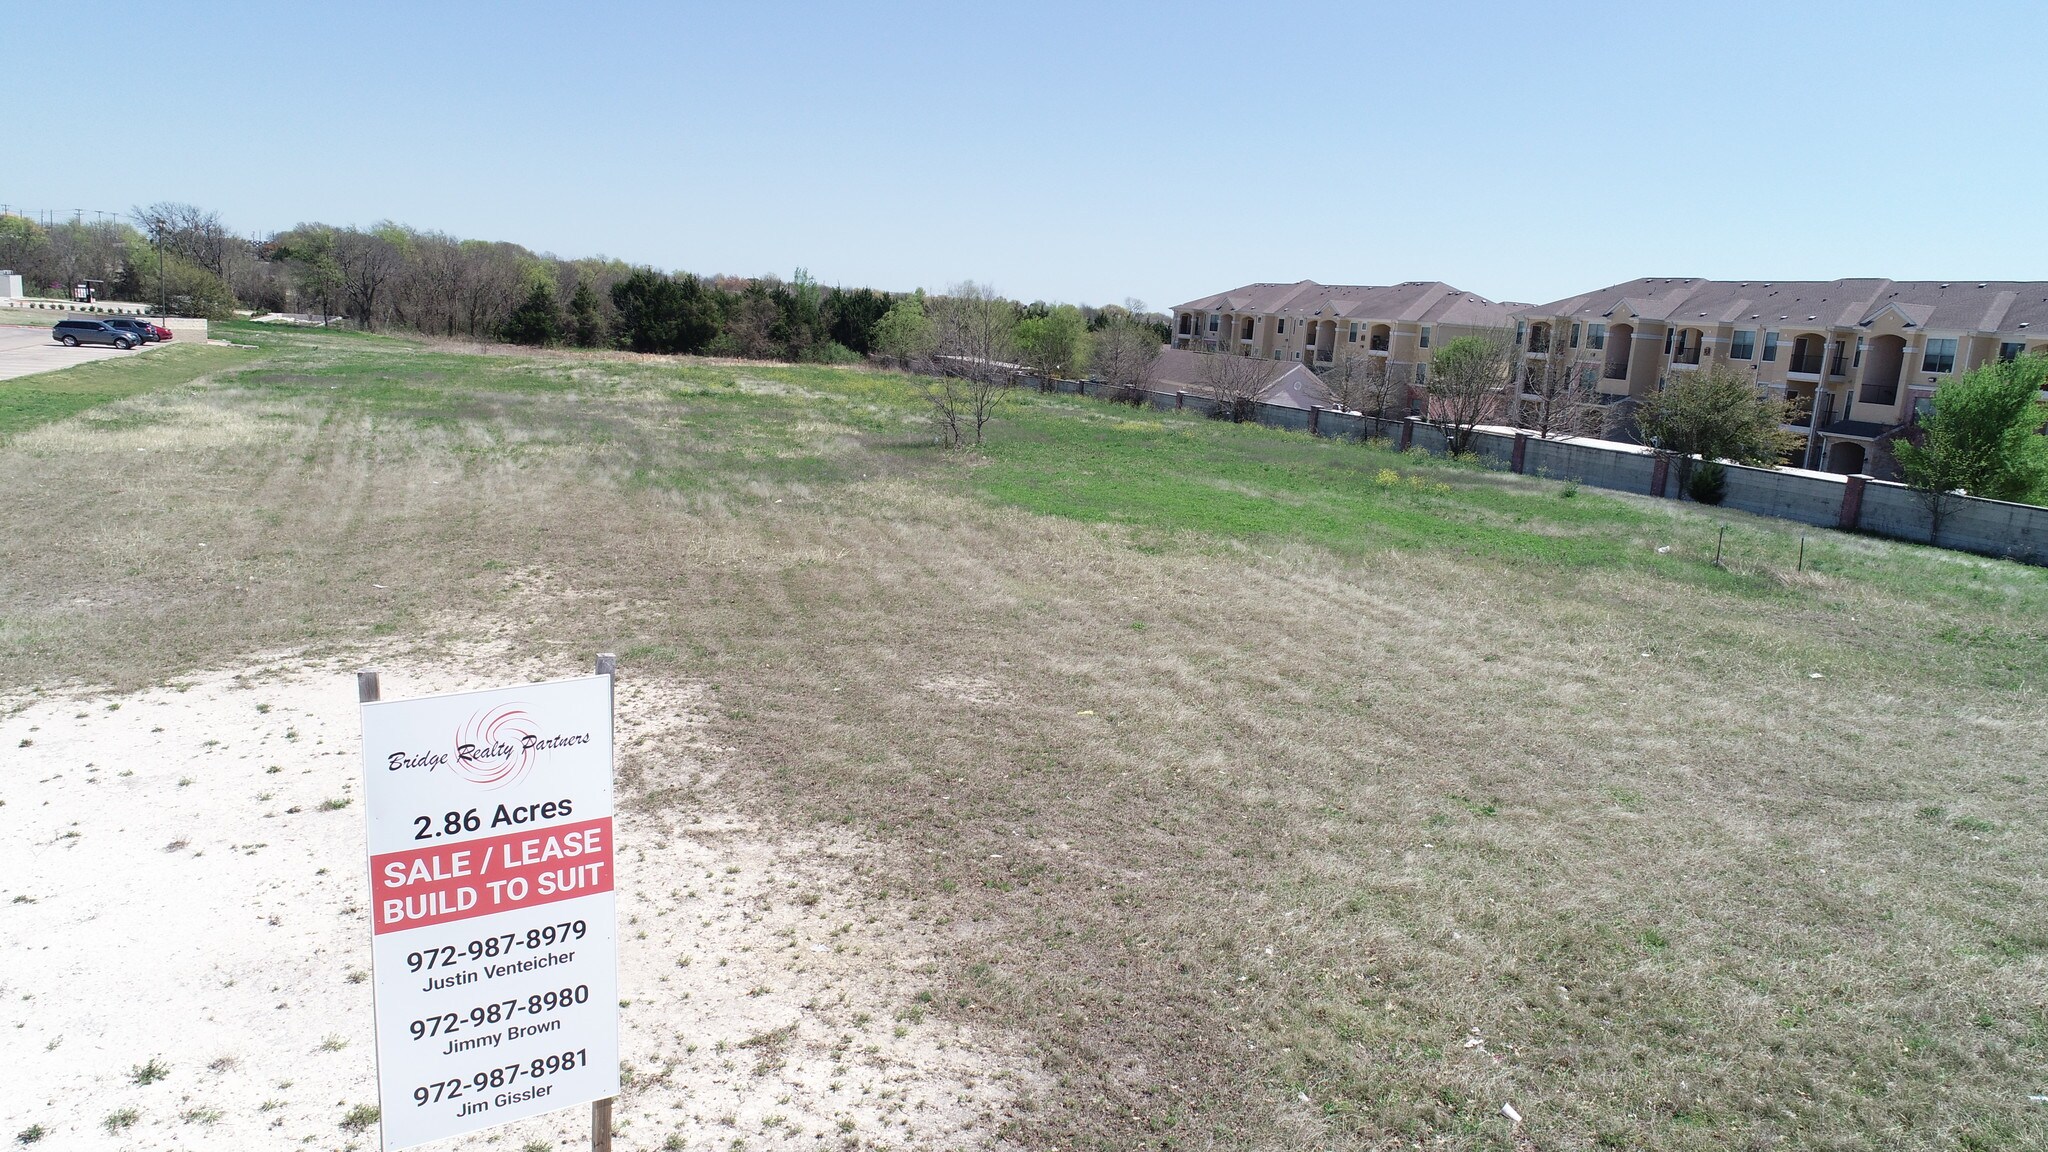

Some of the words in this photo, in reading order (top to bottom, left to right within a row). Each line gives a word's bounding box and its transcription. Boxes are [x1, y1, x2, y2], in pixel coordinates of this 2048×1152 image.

[388, 750, 448, 772] Bridge
[457, 742, 514, 763] Realty
[521, 732, 590, 755] Partners
[413, 808, 481, 840] 2.86
[491, 798, 573, 828] Acres
[384, 851, 471, 888] SALE
[480, 847, 493, 875] /
[504, 828, 602, 868] LEASE
[383, 887, 477, 925] BUILD
[487, 877, 528, 904] TO
[537, 862, 604, 896] SUIT
[406, 920, 587, 973] 972-987-8979
[423, 970, 478, 992] Justin
[484, 950, 575, 979] Venteicher
[410, 984, 589, 1041] 972-987-8980
[443, 1033, 502, 1055] Jimmy
[508, 1019, 561, 1041] Brown
[413, 1048, 587, 1107] 972-987-8981
[457, 1100, 488, 1118] Jim
[495, 1083, 553, 1107] Gissler
